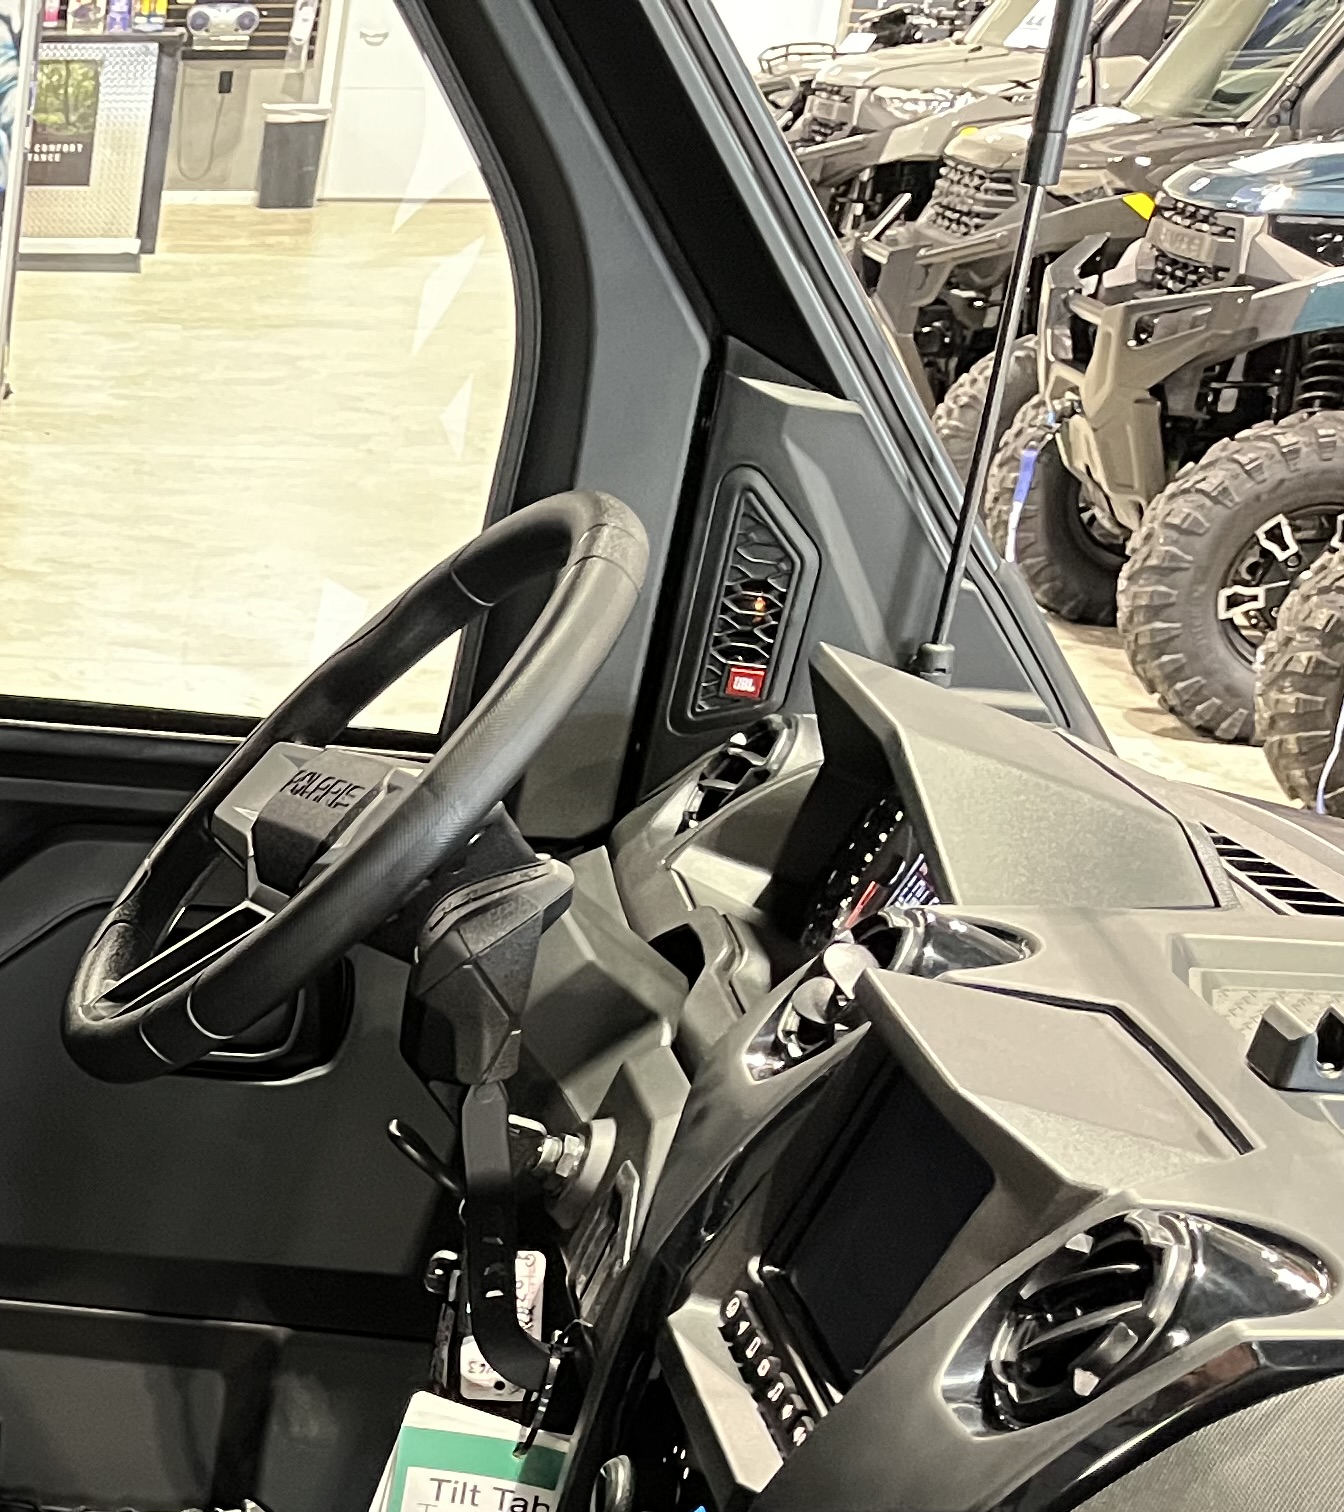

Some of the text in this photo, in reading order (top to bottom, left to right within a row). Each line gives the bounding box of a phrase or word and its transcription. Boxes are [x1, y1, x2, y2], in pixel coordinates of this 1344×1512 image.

[732, 675, 756, 693] JBL
[279, 769, 366, 809] POLARIS
[430, 1477, 481, 1507] Tilt
